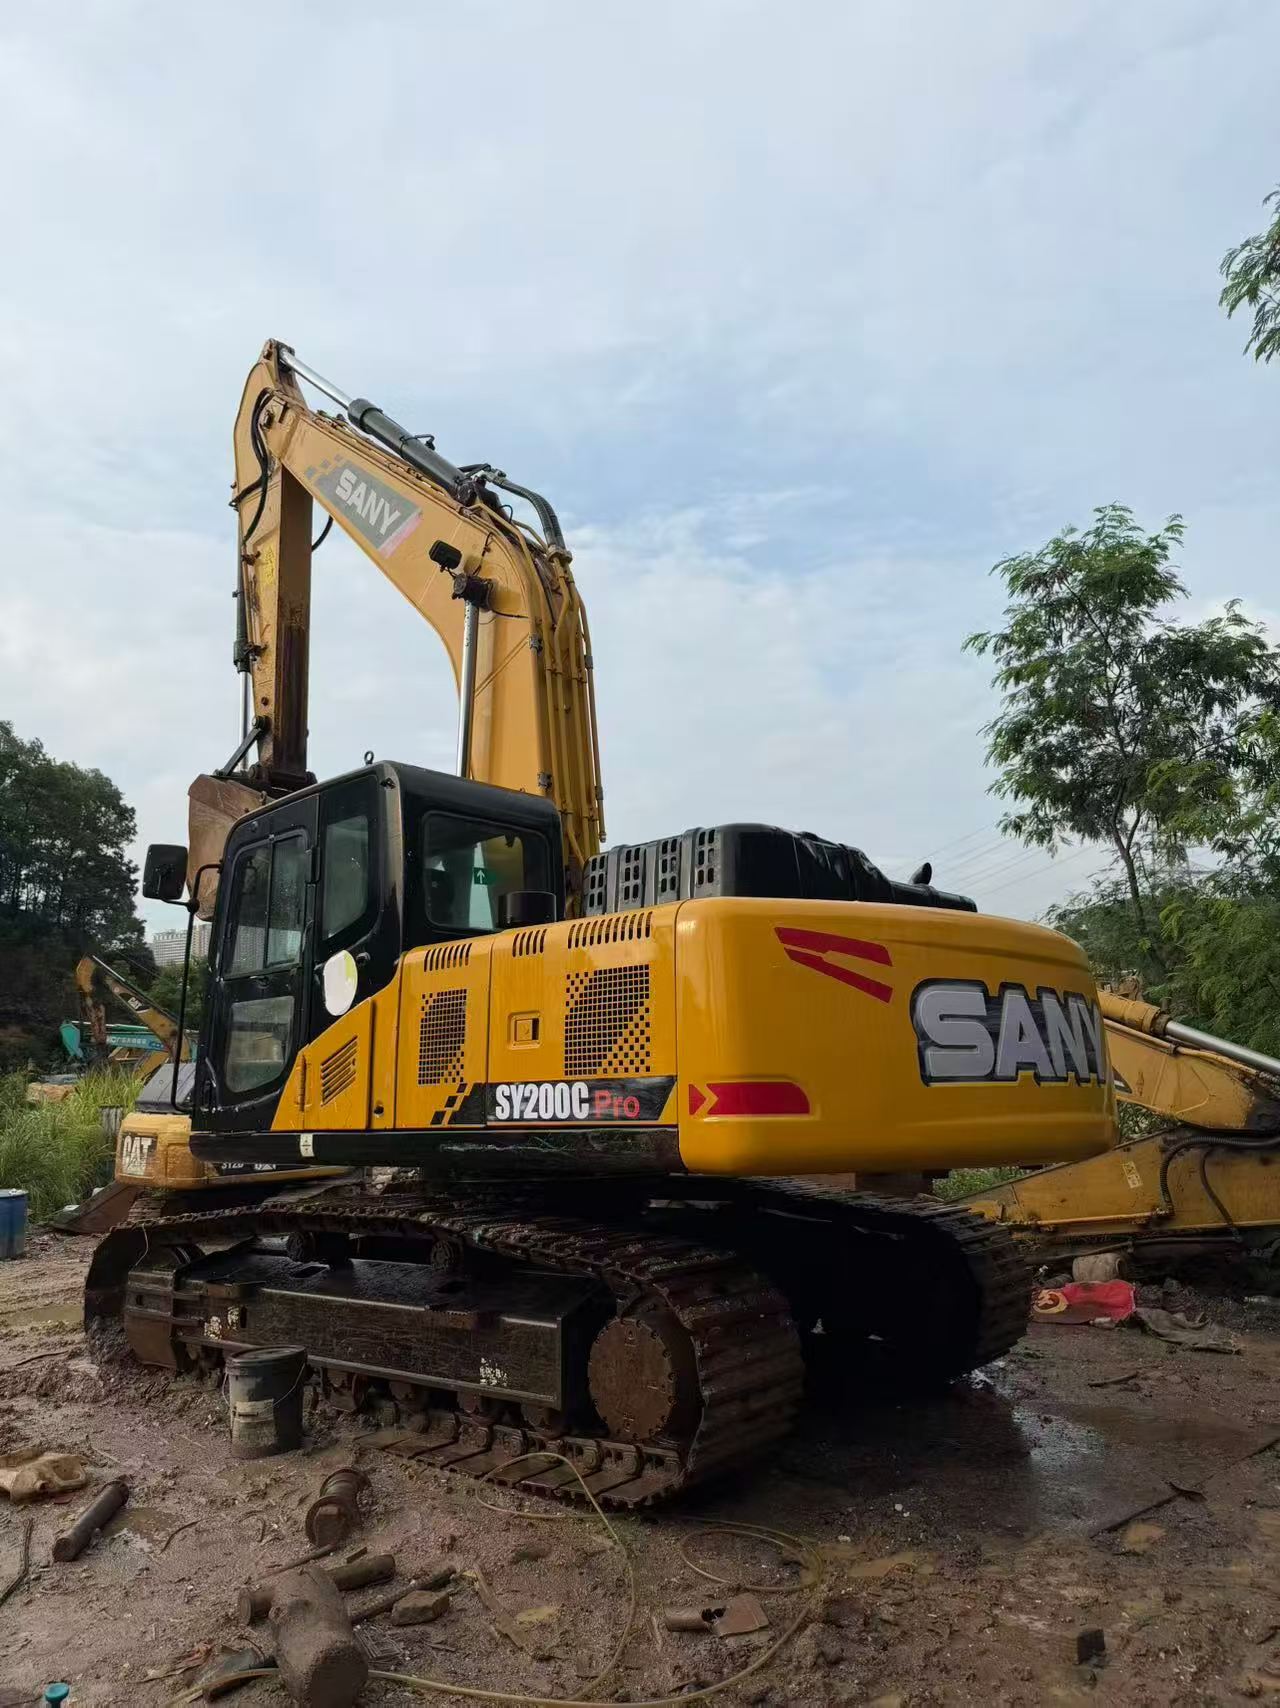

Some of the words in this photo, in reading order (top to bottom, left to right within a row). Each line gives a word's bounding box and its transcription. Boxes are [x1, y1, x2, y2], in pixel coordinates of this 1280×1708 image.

[335, 468, 401, 536] SANY
[913, 981, 1106, 1082] SANY
[495, 1081, 590, 1120] SY200C
[594, 1090, 640, 1119] Pro
[122, 1135, 153, 1176] CAT
